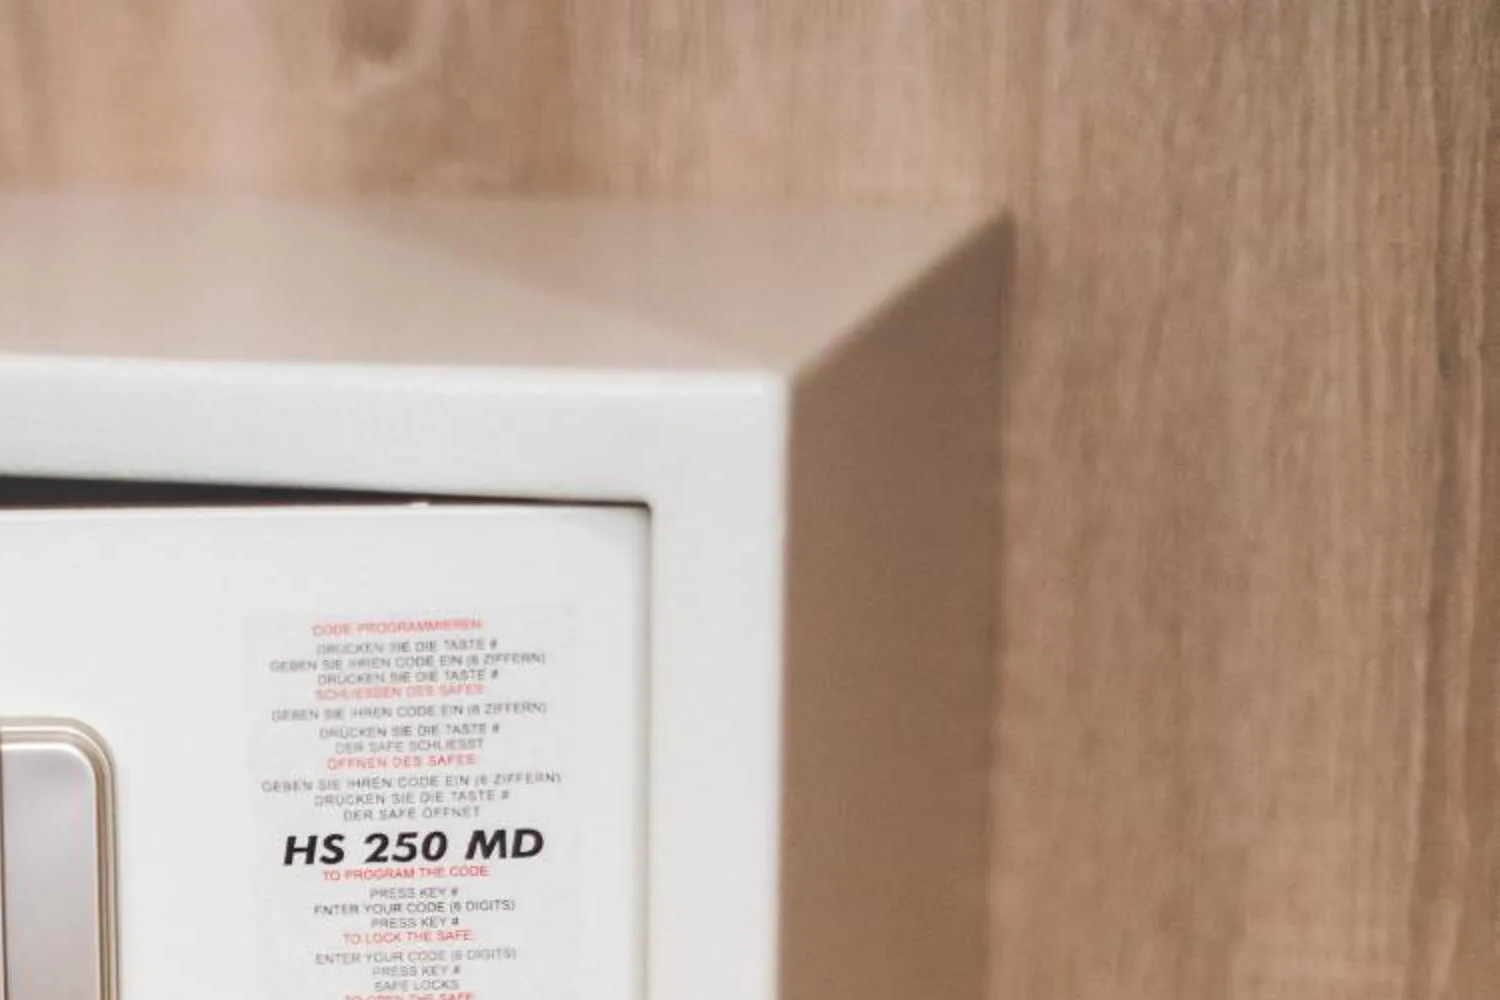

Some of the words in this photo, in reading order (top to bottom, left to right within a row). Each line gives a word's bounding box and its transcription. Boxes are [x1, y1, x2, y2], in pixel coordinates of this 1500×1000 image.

[312, 625, 349, 636] CODE
[323, 660, 341, 670] SIE
[395, 657, 434, 668] CODE
[440, 656, 460, 666] EIN
[397, 707, 434, 717] CODE
[442, 706, 463, 716] EIN
[369, 742, 404, 752] SAFE
[318, 780, 341, 790] SIE
[398, 777, 439, 787] CODE
[446, 776, 468, 786] EIN
[392, 794, 414, 804] SIE
[420, 793, 444, 803] DIE
[452, 792, 494, 802] TASTE
[344, 810, 372, 820] DER
[379, 809, 416, 819] SAFE
[284, 834, 345, 866] HS
[364, 831, 448, 863] 250
[465, 829, 544, 860] MD
[345, 868, 414, 880] PROGRAM
[419, 867, 445, 877] THE
[370, 888, 415, 899] PRESS
[420, 888, 447, 898] KEY
[315, 904, 359, 915] ENTER
[363, 903, 401, 914] YOUR
[405, 902, 445, 913] CODE
[466, 901, 515, 911] DIGITS)
[371, 918, 416, 928] PRESS
[421, 917, 447, 927] KEY
[366, 933, 401, 943] LOCK
[408, 932, 431, 942] THE
[316, 954, 360, 964] ENTER
[365, 952, 402, 963] YOUR
[408, 951, 445, 962] CODE
[468, 949, 516, 960] DIGITS)
[373, 966, 416, 977] PRESS
[423, 965, 447, 975] KEY
[375, 981, 408, 991] SAFE
[414, 979, 459, 990] LOCKS
